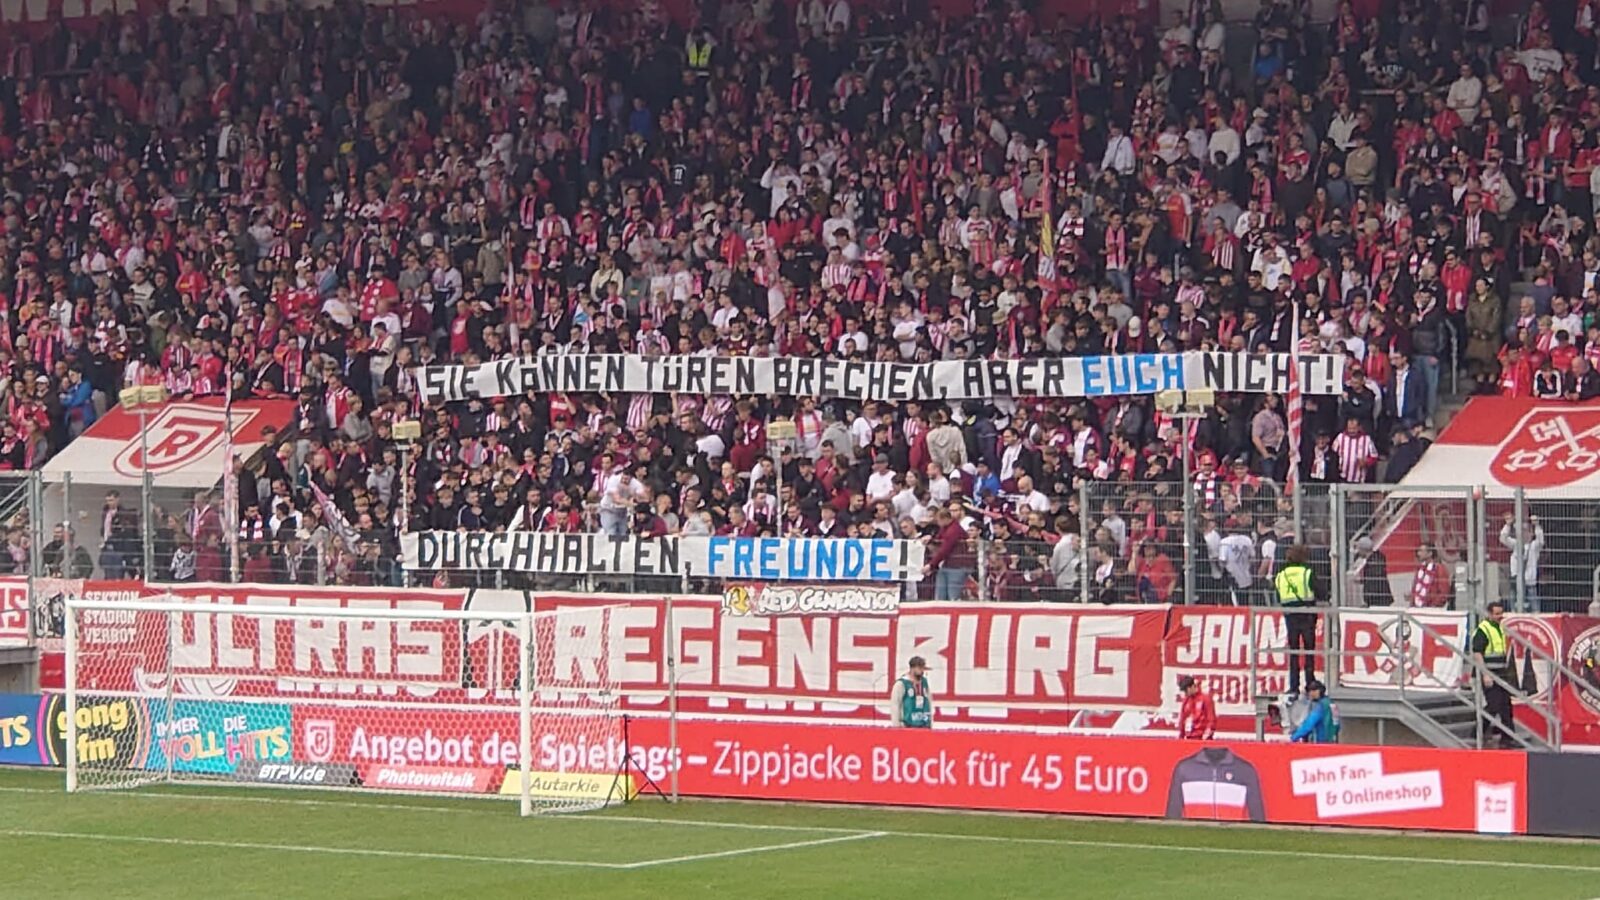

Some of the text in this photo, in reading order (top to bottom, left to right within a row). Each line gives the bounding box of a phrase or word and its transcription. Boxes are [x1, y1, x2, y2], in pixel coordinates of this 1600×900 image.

[425, 352, 1334, 401] SIE KÖNNEN TÜREN BRECHEN, ABER EUCH NICHT!
[418, 532, 908, 580] DURCHHALTEN, FREUNDE!
[757, 585, 900, 615] RED GENERATION
[83, 608, 139, 625] STADION
[83, 626, 138, 644] VERBOT
[171, 595, 1134, 698] ULTRAS REGENSBURG
[1176, 614, 1289, 666] JAHN
[222, 714, 248, 734] DIE
[76, 733, 117, 764] fm
[159, 726, 290, 764] VOLL HITS
[349, 725, 475, 767] Angebot
[481, 730, 522, 766] de
[712, 740, 862, 786] Zippjacke
[871, 746, 957, 785] Block
[966, 749, 1012, 788] für
[1020, 753, 1063, 790] 45
[1074, 755, 1149, 794] Euro
[258, 764, 326, 782] BTPV.de
[376, 767, 476, 788] Photovoltaik
[530, 776, 601, 794] Autarkie
[1302, 765, 1374, 785] Jahn Fan-
[1326, 783, 1433, 806] & Onlineshop
